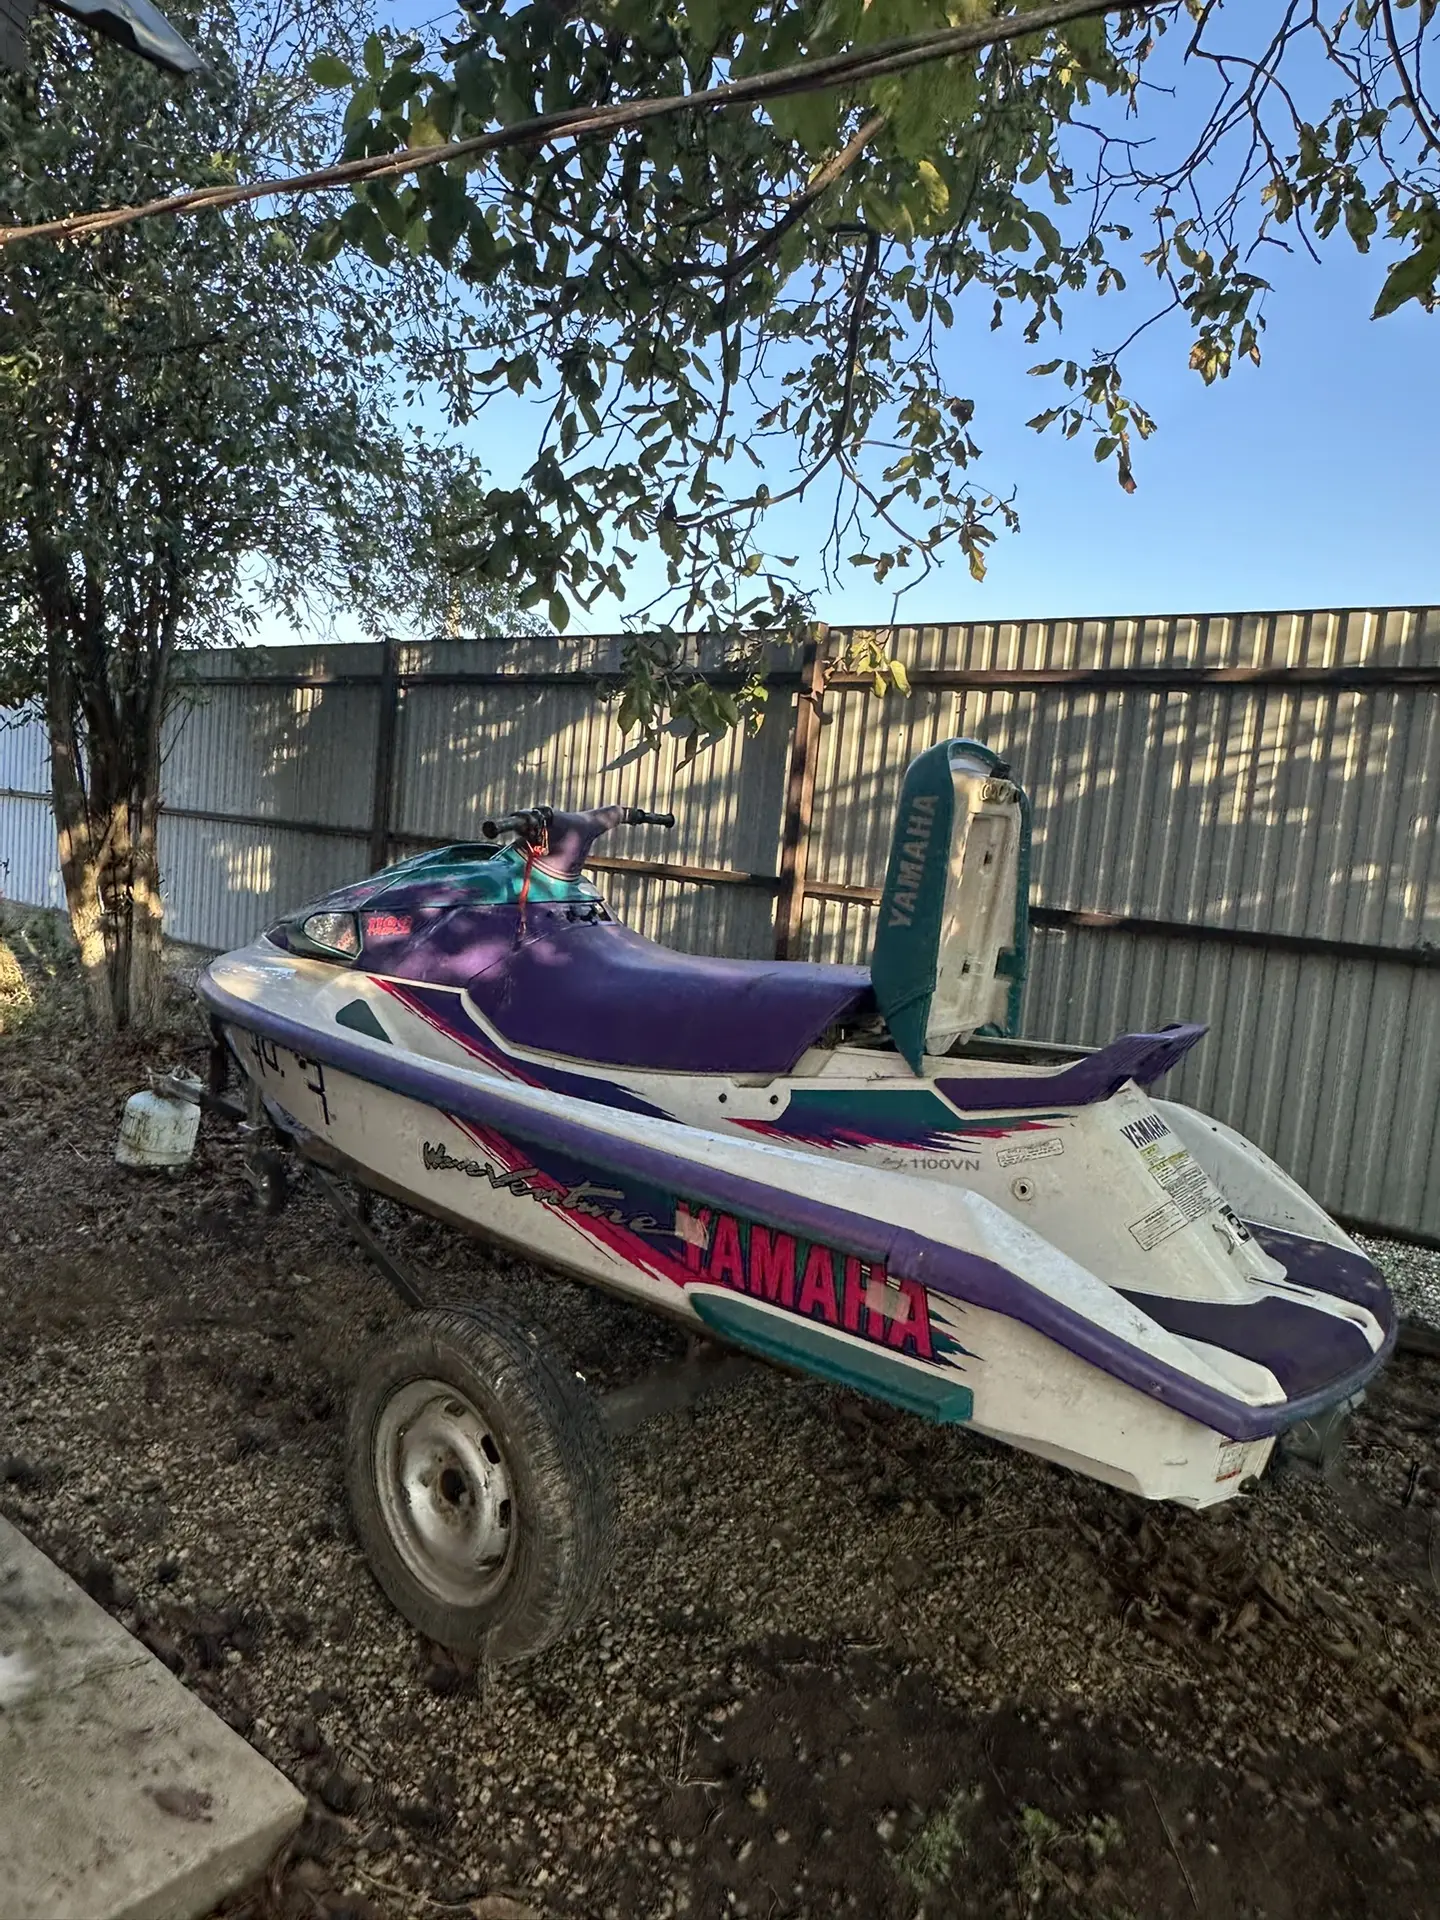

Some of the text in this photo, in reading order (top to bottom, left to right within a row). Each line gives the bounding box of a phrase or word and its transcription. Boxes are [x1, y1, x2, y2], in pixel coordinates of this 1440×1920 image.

[888, 796, 940, 928] YAMAHA
[912, 1158, 980, 1171] 1100VN
[1119, 1113, 1172, 1149] YAMAHA
[676, 1200, 933, 1358] YAMAHA
